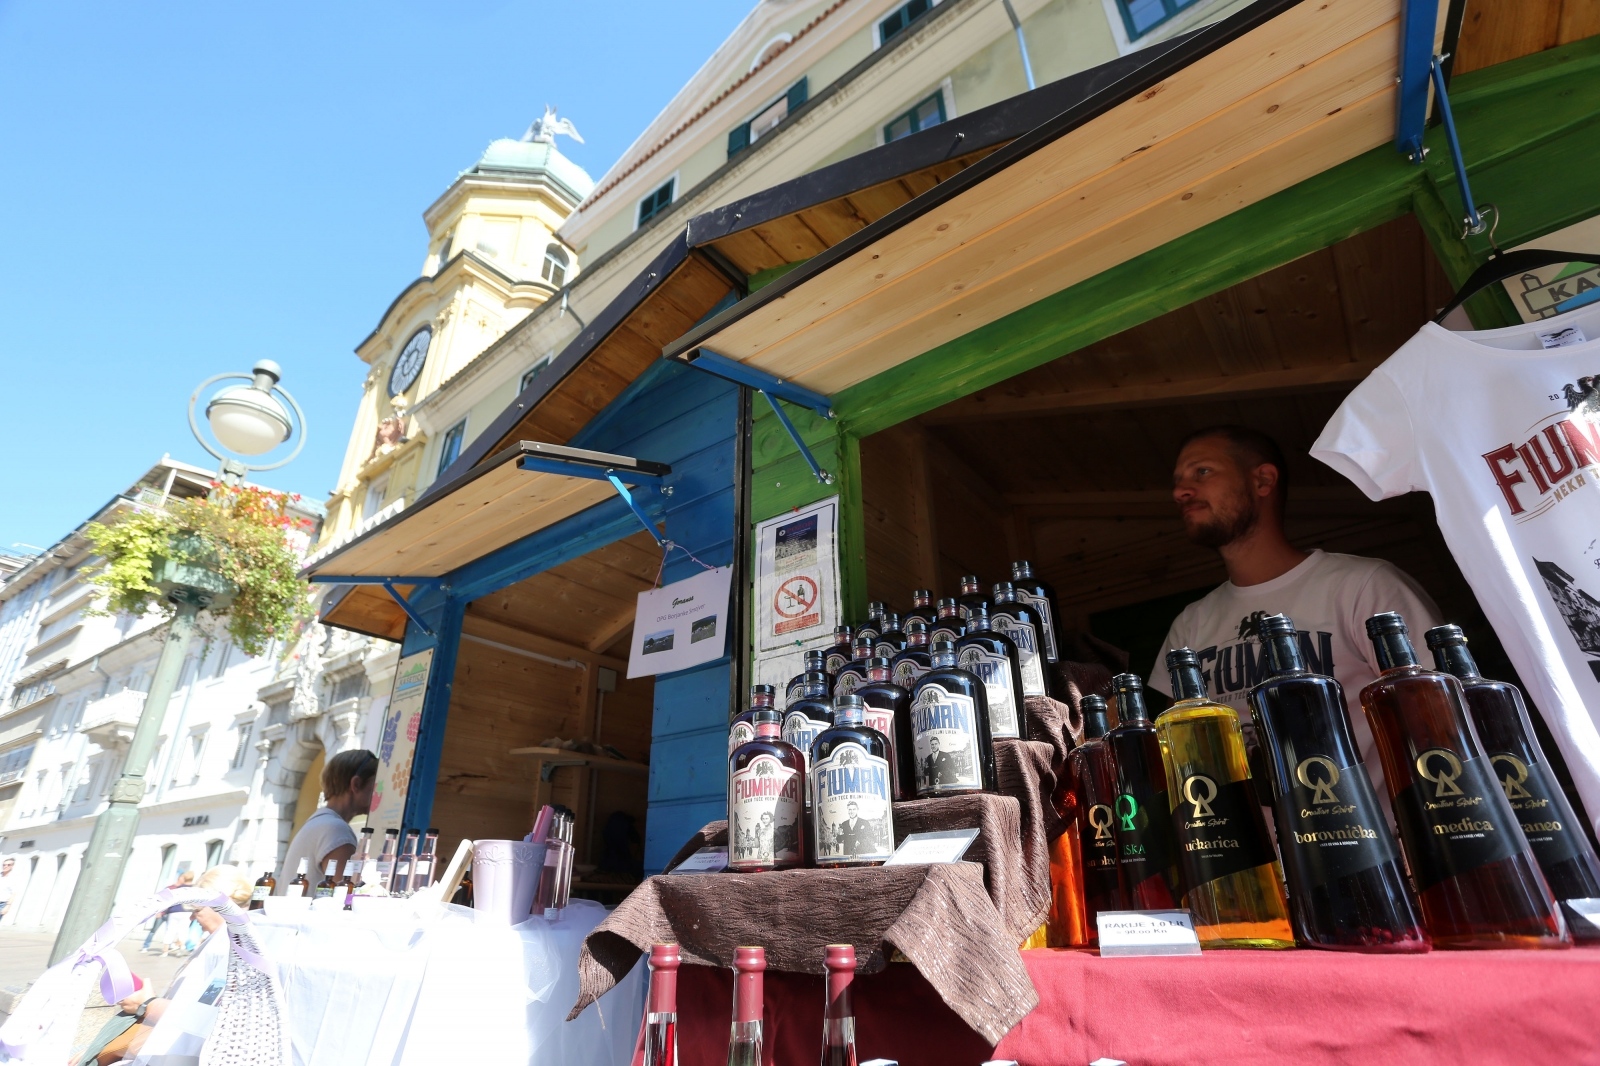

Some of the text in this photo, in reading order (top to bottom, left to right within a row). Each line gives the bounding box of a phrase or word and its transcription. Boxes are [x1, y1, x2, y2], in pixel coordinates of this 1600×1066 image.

[1548, 271, 1600, 302] KA
[1553, 474, 1587, 503] NEKA
[911, 701, 970, 735] FIUMAN
[735, 778, 799, 804] FIUMANKA
[817, 765, 887, 804] FIUMAN
[182, 815, 209, 827] ZARA
[1293, 824, 1378, 844] borovnička
[1433, 817, 1495, 835] medica
[1185, 835, 1240, 852] učkarica
